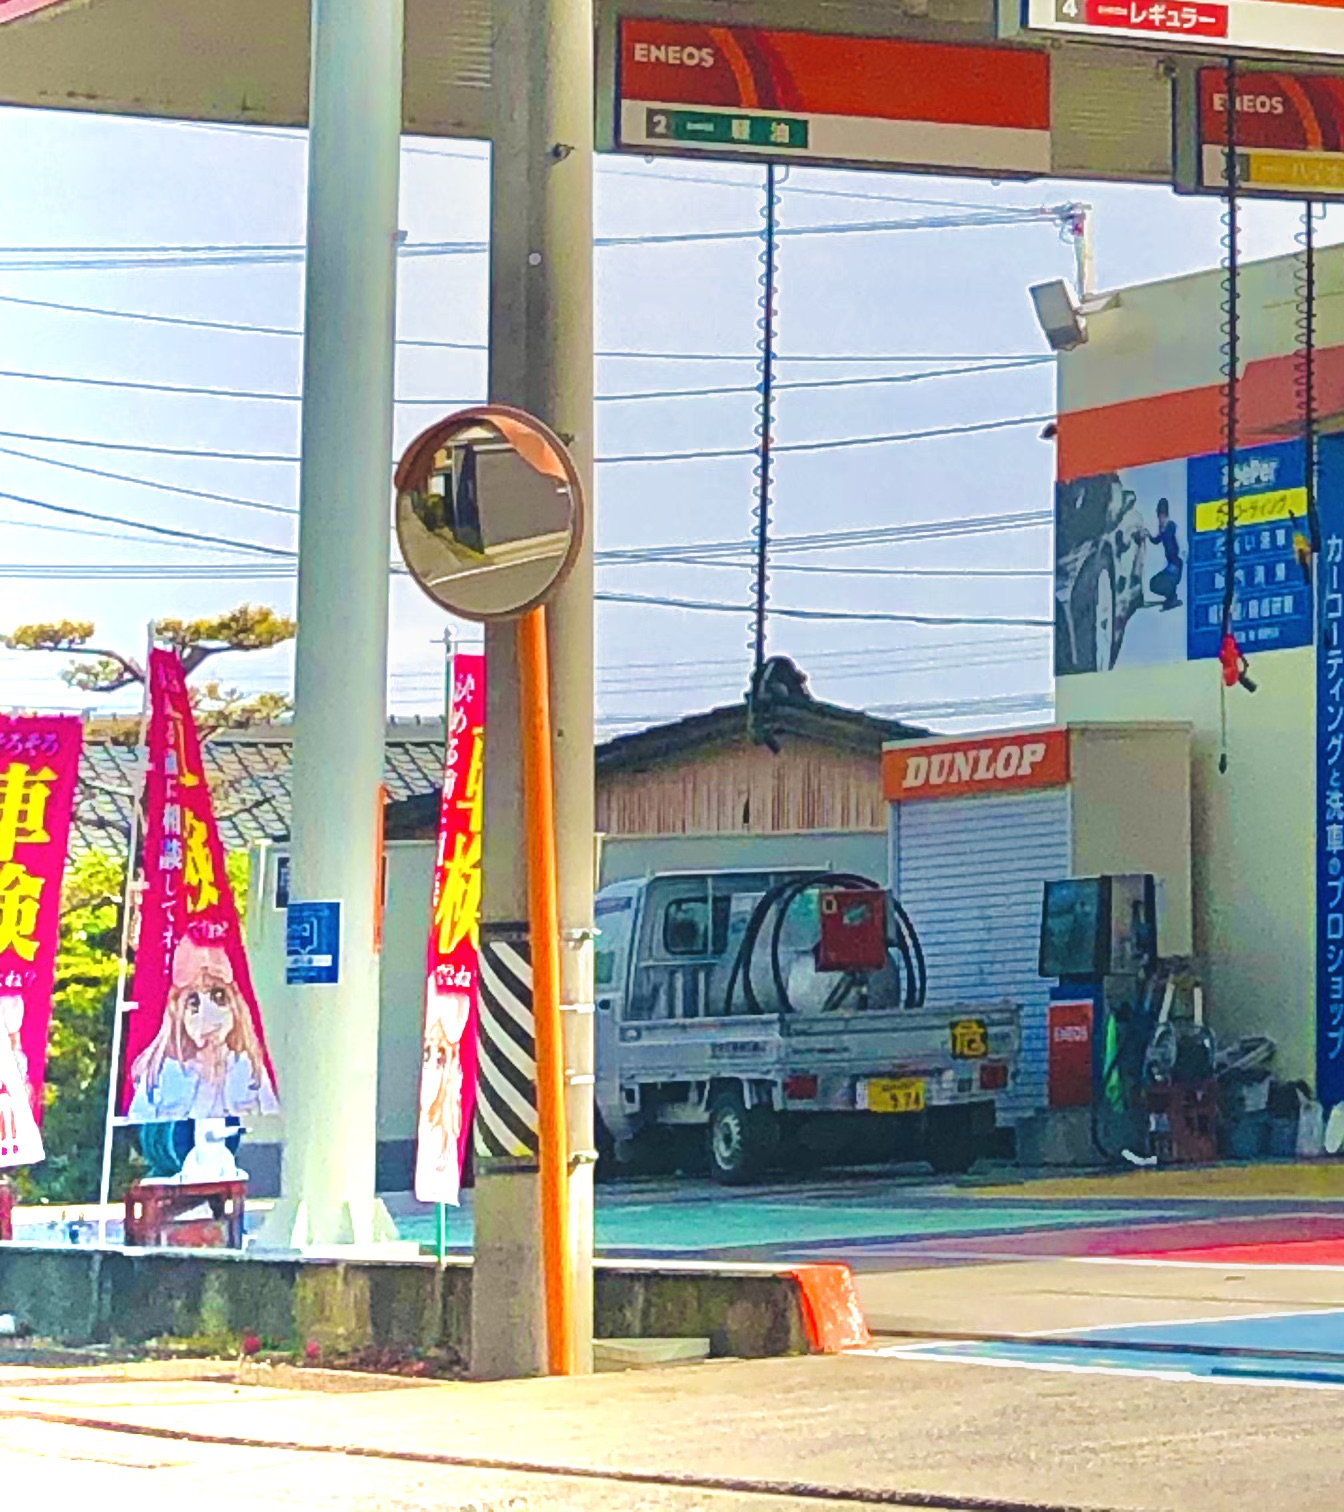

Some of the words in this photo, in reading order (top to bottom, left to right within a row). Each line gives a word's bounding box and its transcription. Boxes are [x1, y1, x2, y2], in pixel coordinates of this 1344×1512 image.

[1130, 2, 1216, 29] レギュラー
[634, 43, 715, 68] ENEOS
[652, 114, 668, 134] 2
[902, 742, 1046, 788] DUNLOP
